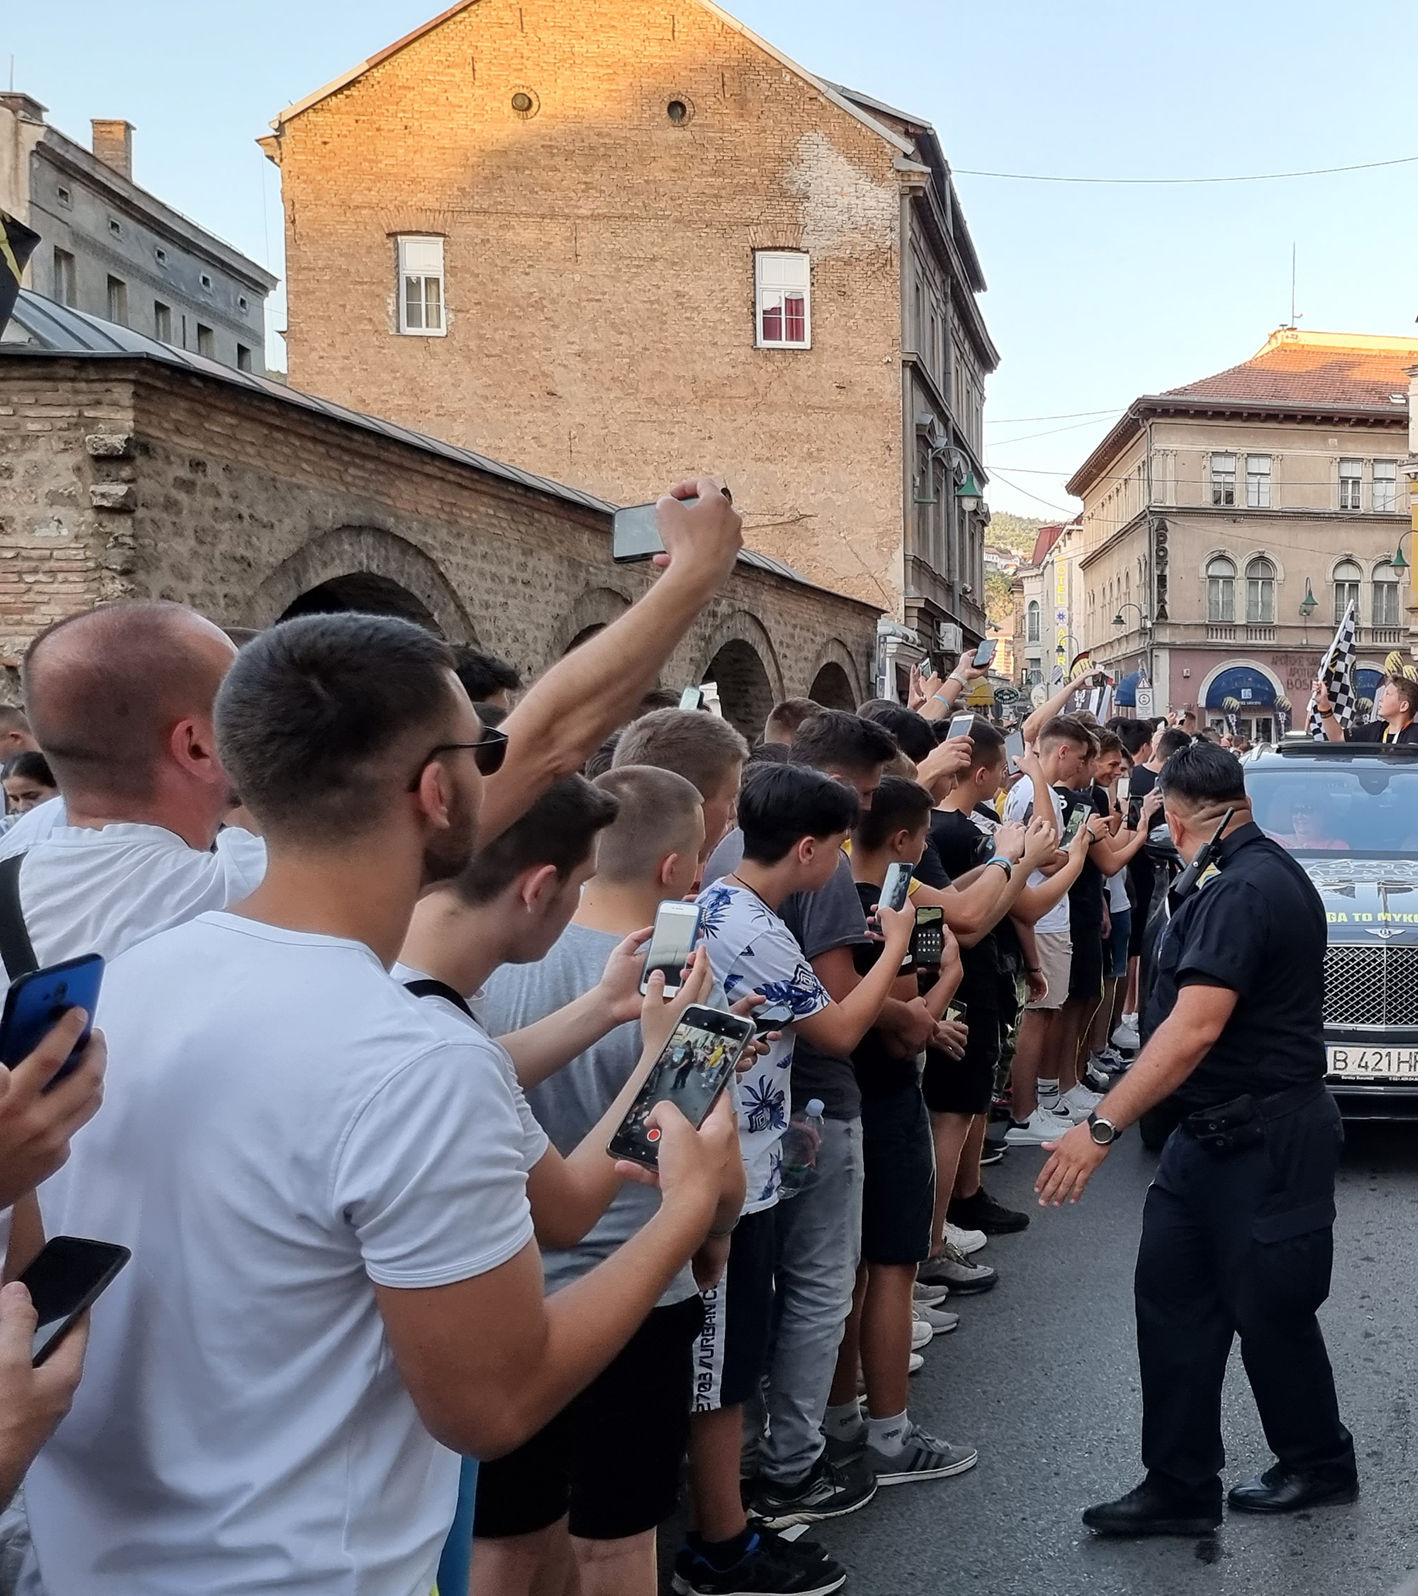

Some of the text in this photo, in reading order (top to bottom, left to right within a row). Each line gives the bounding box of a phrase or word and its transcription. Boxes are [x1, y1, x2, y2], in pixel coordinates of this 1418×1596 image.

[1056, 555, 1067, 604] HOTEL
[1326, 912, 1347, 923] GA
[1352, 913, 1372, 922] TO
[1333, 1050, 1348, 1071] B
